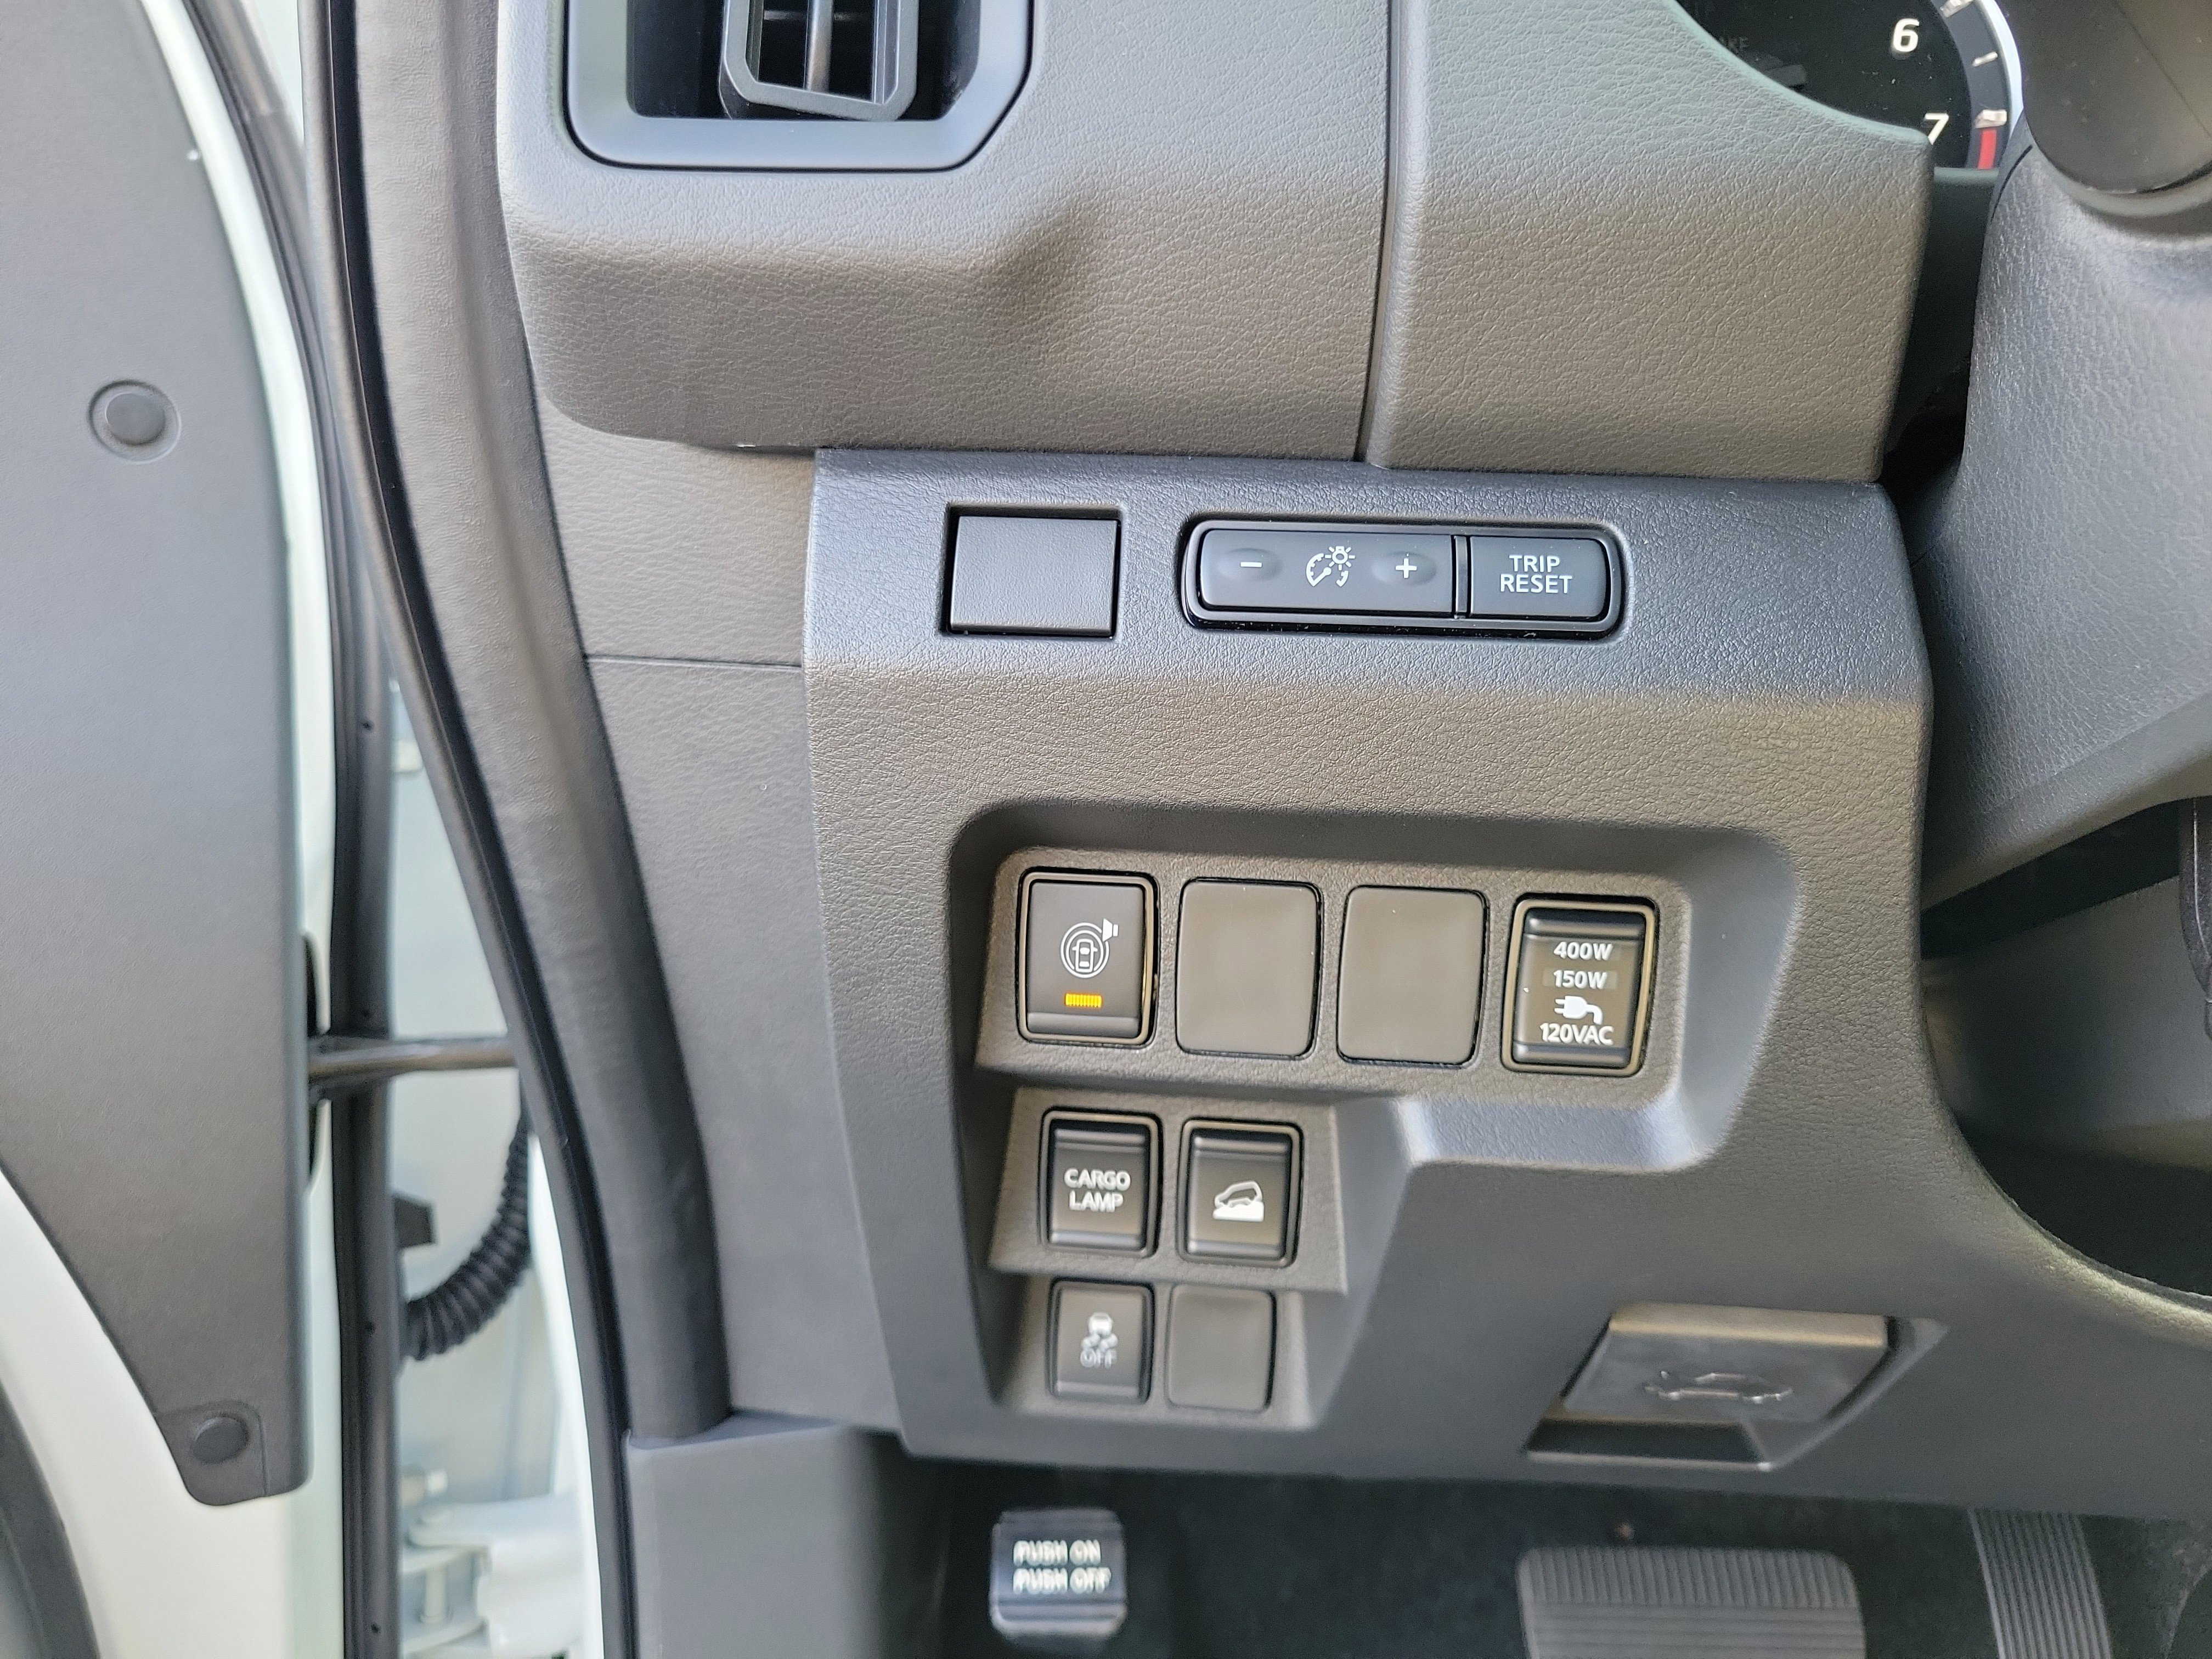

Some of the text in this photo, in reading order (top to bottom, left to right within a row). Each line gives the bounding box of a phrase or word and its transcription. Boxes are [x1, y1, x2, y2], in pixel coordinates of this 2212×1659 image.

[1893, 18, 1919, 52] 6
[1923, 113, 1949, 144] 7
[1509, 555, 1560, 573] TRIP
[1500, 573, 1573, 594] RESET
[1553, 941, 1613, 960] 400W
[1553, 969, 1607, 989] 150W
[1539, 1023, 1614, 1046] 120VAC
[1064, 1169, 1131, 1190] CARGO
[1069, 1191, 1124, 1212] LAMP
[1080, 1348, 1116, 1368] OFF
[1013, 1539, 1101, 1565] PUSH ON
[1013, 1567, 1111, 1595] PUSH OFF
